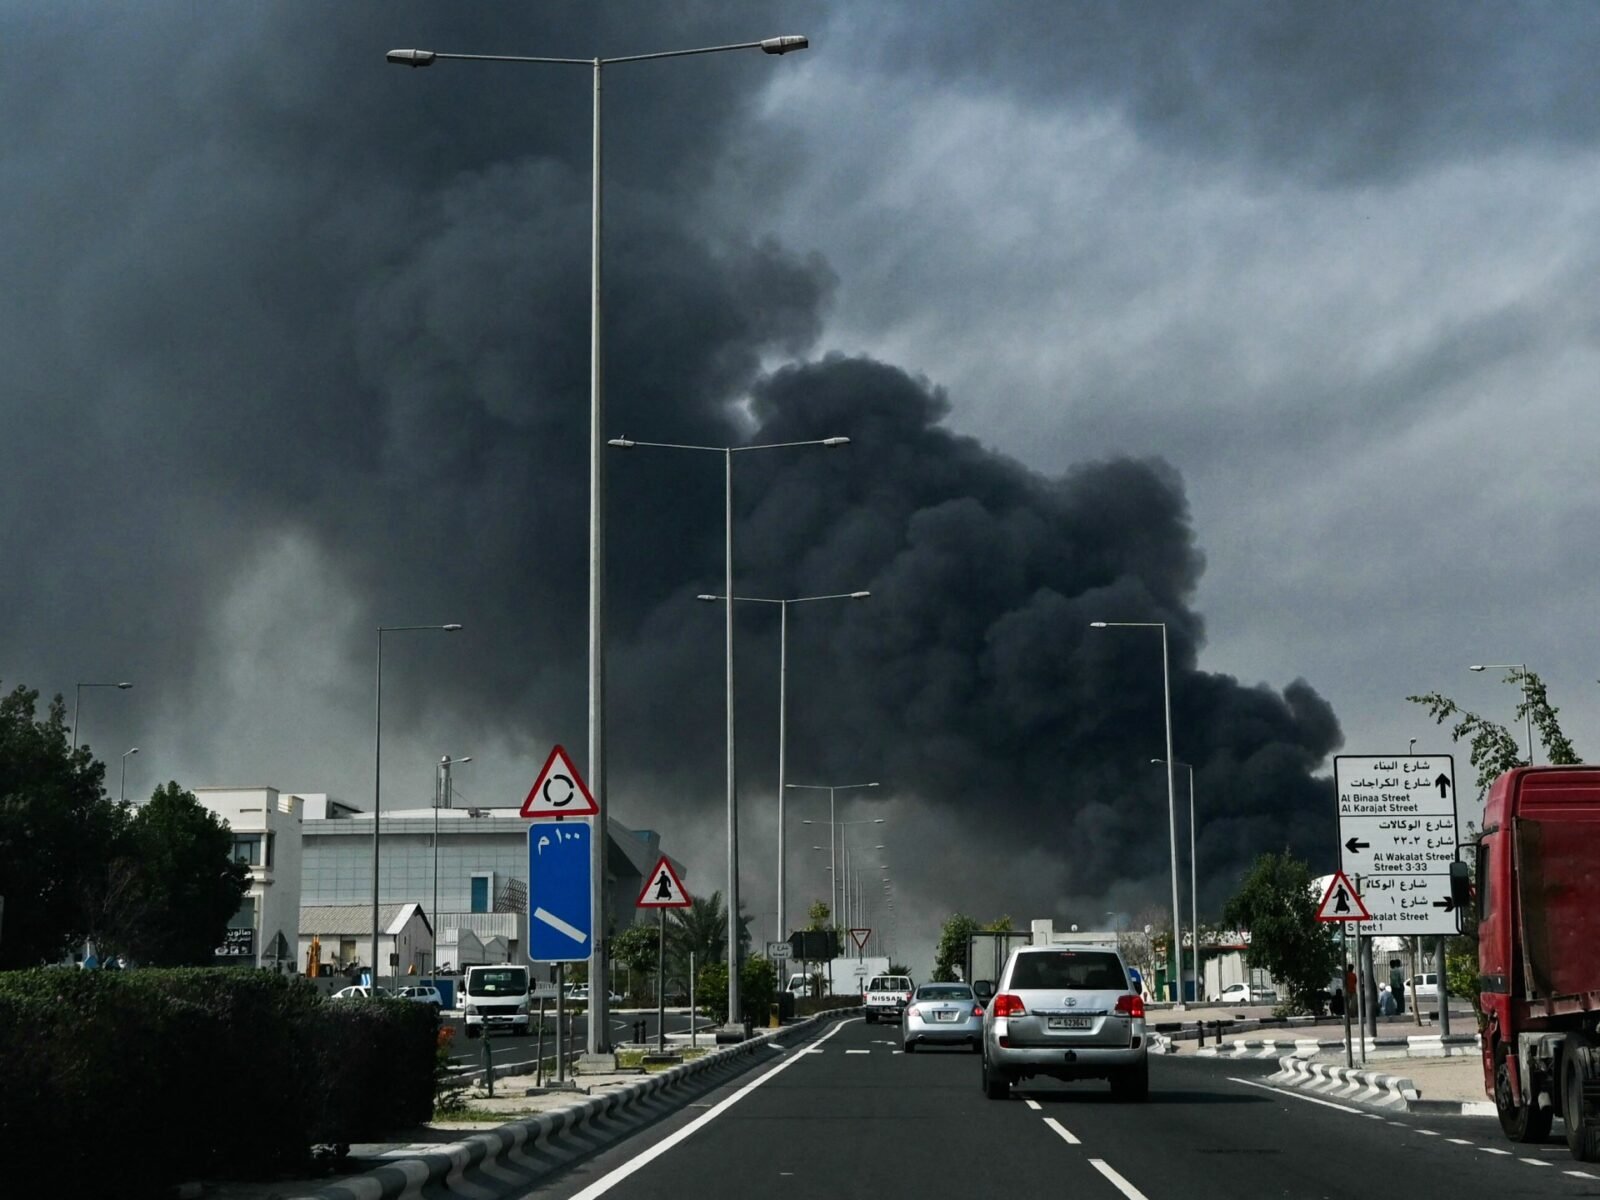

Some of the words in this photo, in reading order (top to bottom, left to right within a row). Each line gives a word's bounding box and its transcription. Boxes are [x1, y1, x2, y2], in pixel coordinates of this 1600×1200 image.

[1373, 760, 1398, 772] البناء
[1403, 760, 1430, 773] شارع
[1350, 778, 1399, 790] الكراجات
[1404, 778, 1431, 790] شارع
[1341, 794, 1351, 802] Al
[1353, 794, 1379, 803] Binaa
[1381, 793, 1411, 802] Street
[1341, 804, 1351, 813] Al
[1353, 804, 1387, 814] Karajat
[1389, 803, 1418, 812] Street
[1379, 820, 1421, 832] الوكالات
[1426, 820, 1453, 832] شارع
[555, 827, 580, 845] ١٠٠
[538, 835, 550, 856] م
[1427, 837, 1455, 849] شارع
[1373, 853, 1383, 861] Al
[1385, 852, 1424, 861] Wakalat
[1425, 852, 1454, 861] Street
[1374, 863, 1403, 872] Street
[1399, 879, 1428, 892] شارع
[1400, 896, 1428, 909] شارع
[1369, 912, 1397, 921] akalat
[1399, 912, 1429, 921] Street
[1379, 923, 1383, 931] 1
